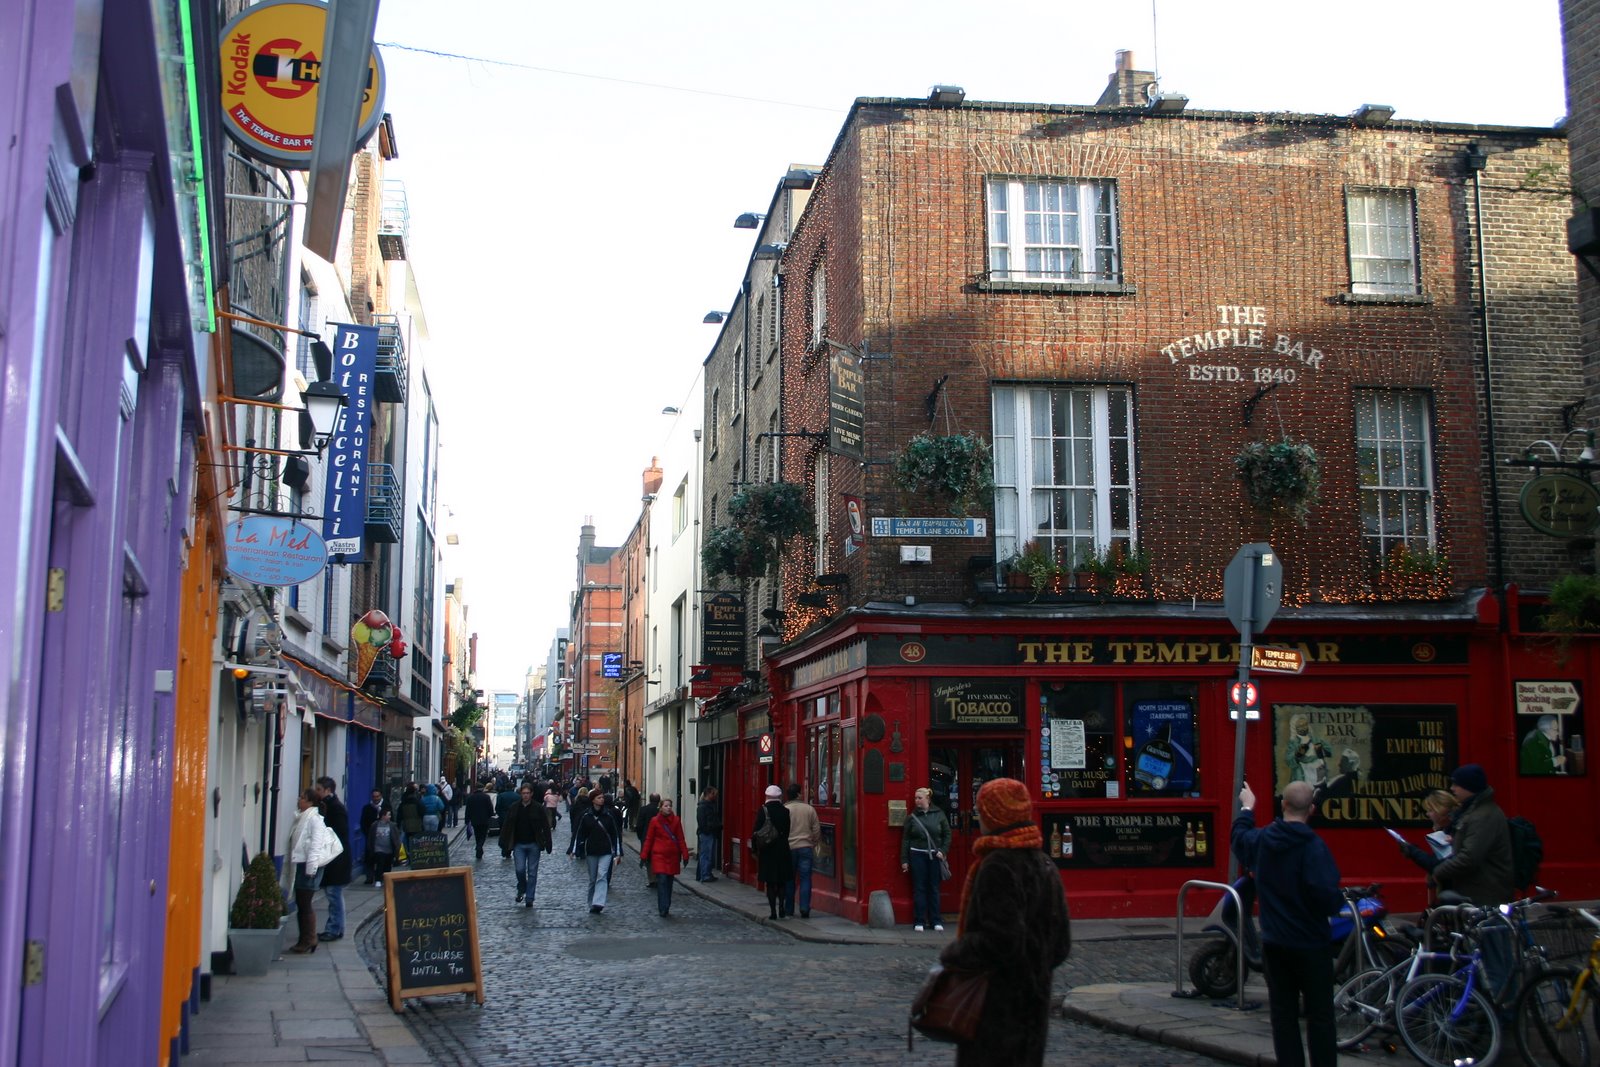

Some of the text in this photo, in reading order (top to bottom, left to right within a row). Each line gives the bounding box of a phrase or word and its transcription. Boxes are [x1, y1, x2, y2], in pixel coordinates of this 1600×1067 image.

[227, 33, 251, 96] Kodak
[236, 109, 250, 125] THE
[250, 119, 280, 144] TEMPLE
[282, 137, 301, 146] BAR
[1217, 305, 1267, 327] THE
[1160, 328, 1324, 370] TEMPLE BAR
[832, 362, 864, 385] TEMPLE
[1187, 364, 1296, 384] ESTD. 1840
[838, 374, 856, 393] BAR
[844, 406, 863, 419] GARDEN
[332, 331, 359, 535] Boticelli
[350, 373, 368, 497] RESTAURANT
[833, 426, 861, 442] LIVE MUSIC
[895, 527, 970, 535] TEMPLE LANE SOUTH
[976, 523, 984, 533] 2
[235, 525, 313, 551] La Med
[333, 540, 356, 549] Nastro
[281, 550, 325, 564] Restaurant
[329, 545, 357, 554] Azzurro
[706, 603, 744, 613] TEMPLE
[714, 611, 736, 620] BAR
[905, 645, 920, 658] 48
[1018, 643, 1094, 663] THE
[1265, 650, 1284, 659] TEMPLE
[1261, 659, 1298, 670] MUSIC CENTRE
[934, 682, 972, 697] Importers
[1518, 684, 1535, 693] Beer
[1537, 684, 1565, 693] Garden
[1518, 694, 1550, 704] Smoking
[945, 697, 1012, 721] TOBACCO
[1525, 704, 1543, 712] Area
[958, 716, 984, 724] Always
[1309, 711, 1368, 724] TEMPLE
[1326, 724, 1355, 741] BAR
[1417, 721, 1444, 736] THE
[1386, 738, 1444, 754] EMPEROR
[1429, 756, 1444, 771] OF
[1321, 797, 1430, 821] GUINNE
[1074, 816, 1181, 826] THE TEMPLE BAR
[402, 914, 464, 929] EARLY BIRD
[411, 952, 464, 963] 2 COURSE
[412, 966, 441, 975] UNTIL
